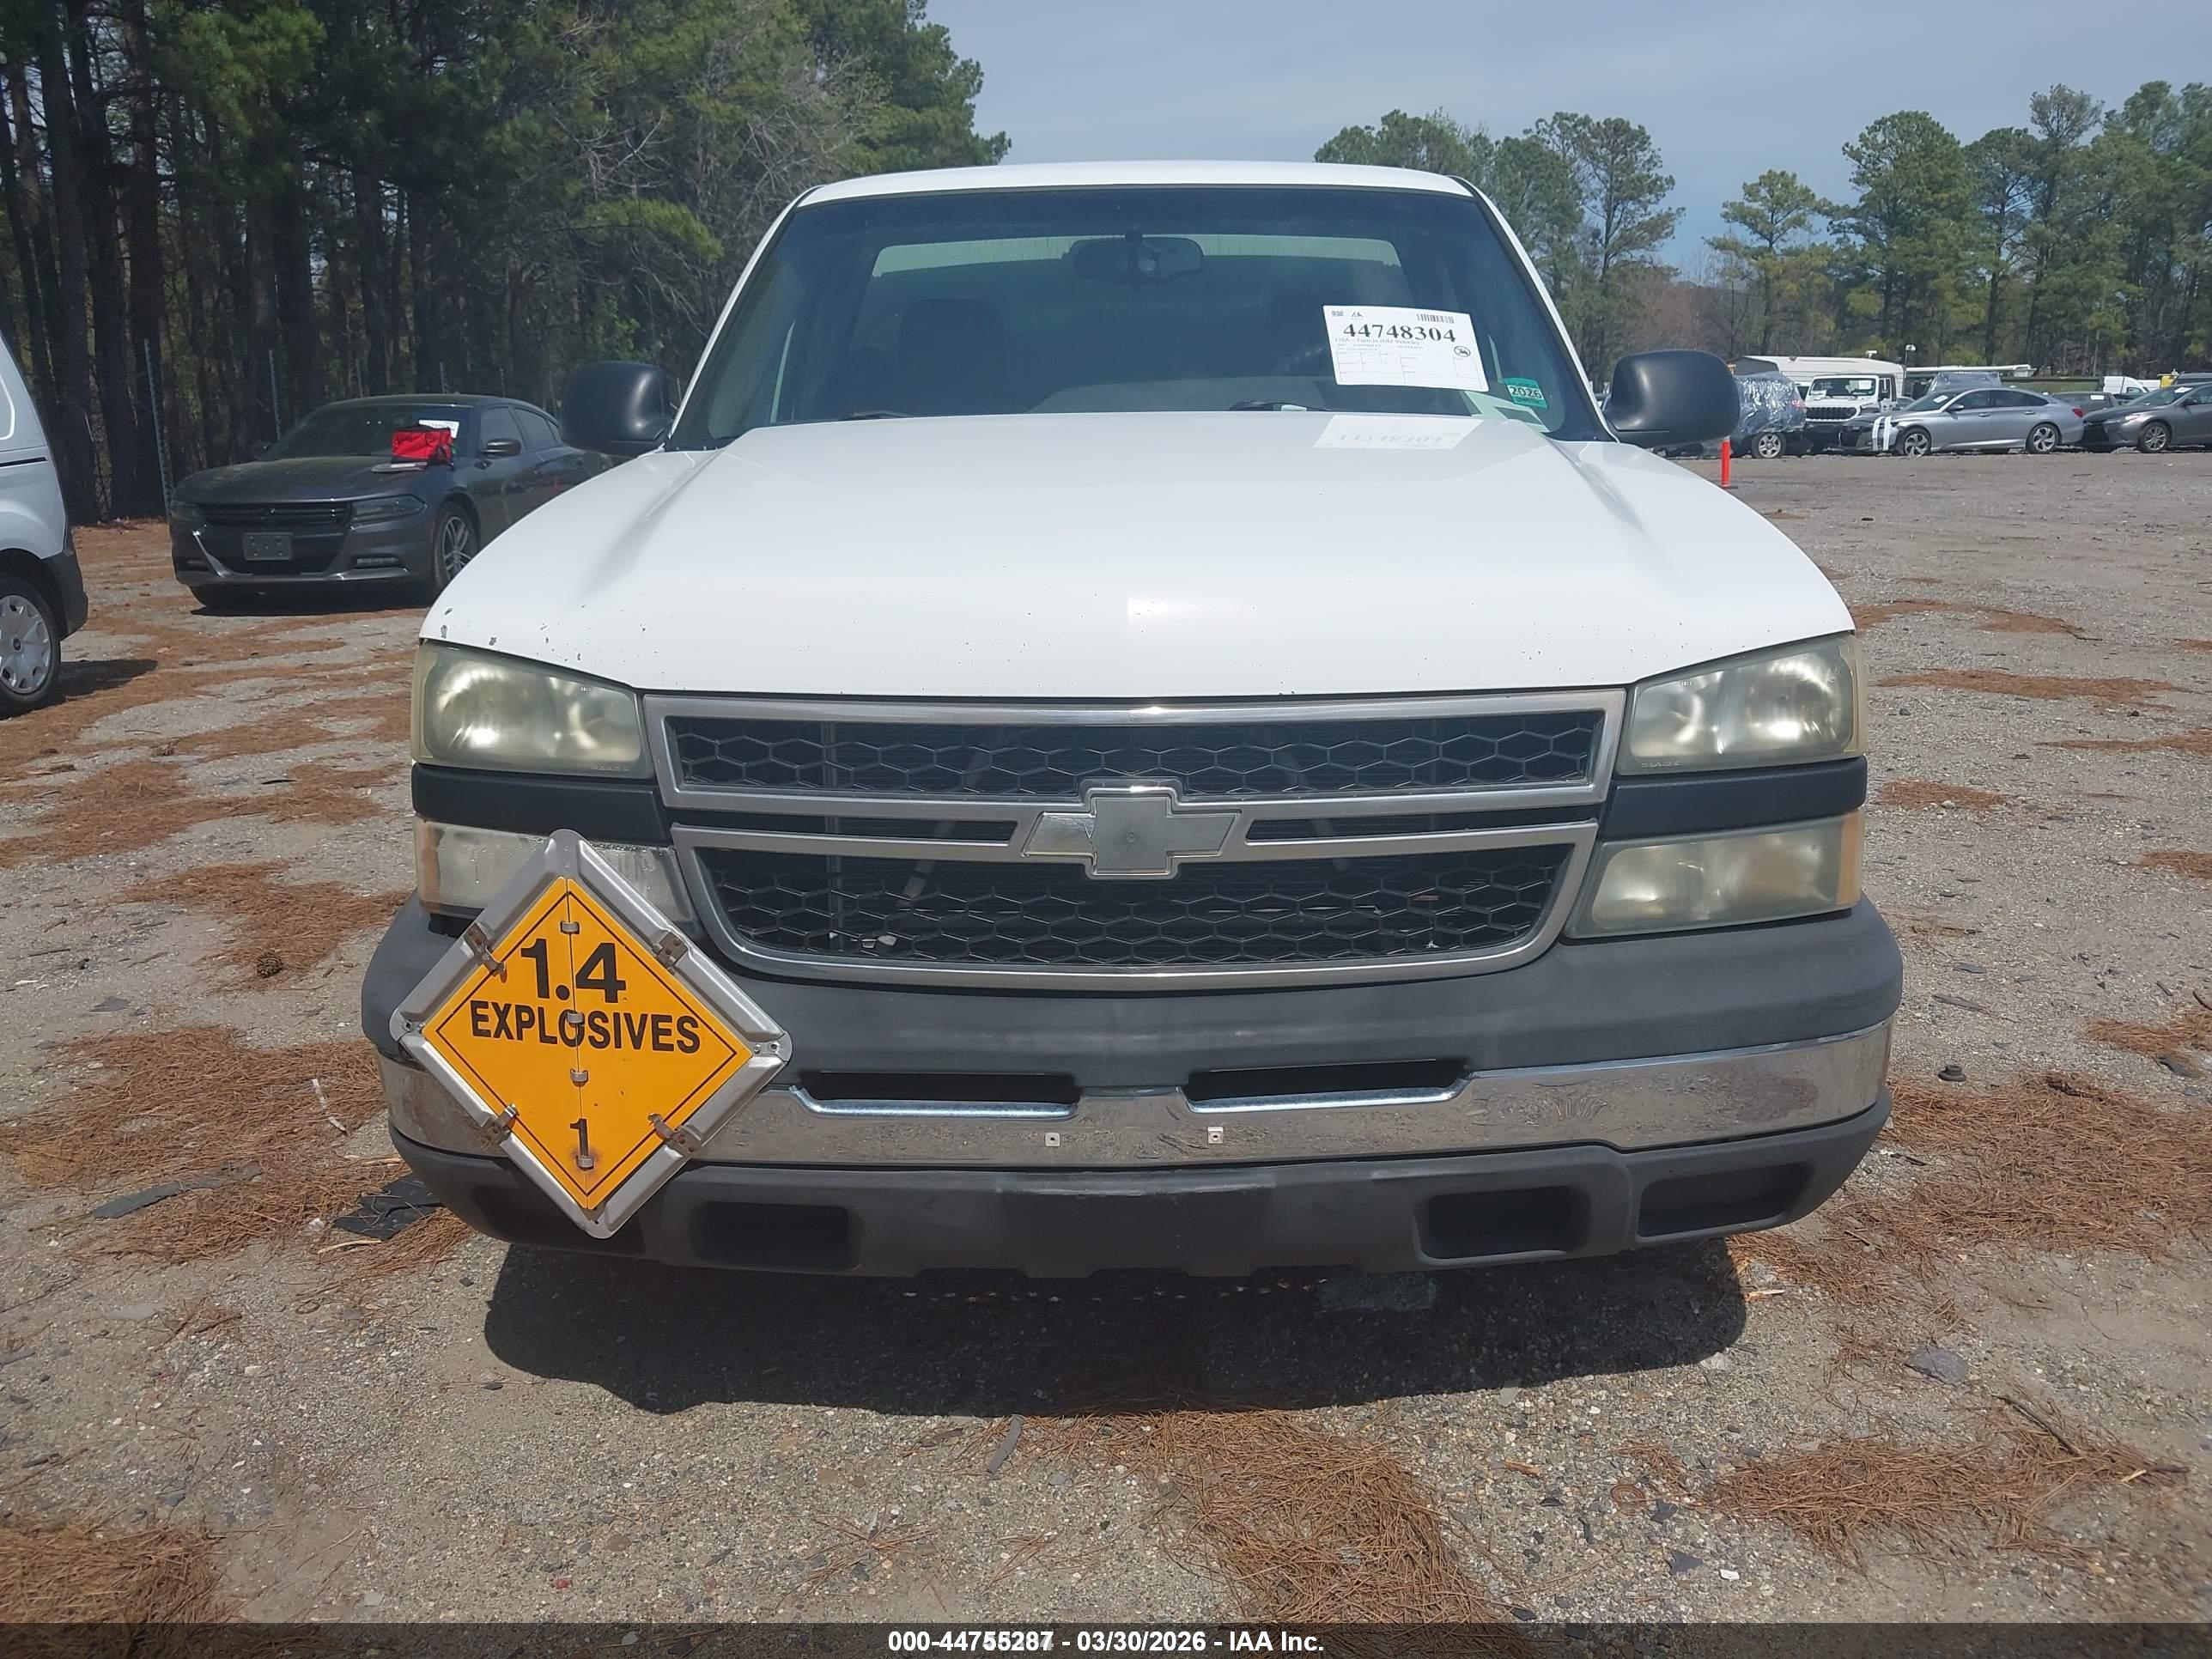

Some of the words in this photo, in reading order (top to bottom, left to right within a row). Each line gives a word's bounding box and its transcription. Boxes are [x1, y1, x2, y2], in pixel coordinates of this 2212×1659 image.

[1343, 324, 1456, 343] 44748304
[1510, 386, 1542, 398] 2026
[521, 939, 626, 1003] 1.4
[471, 1000, 701, 1054] EXPLOSIVES
[569, 1119, 589, 1157] 1
